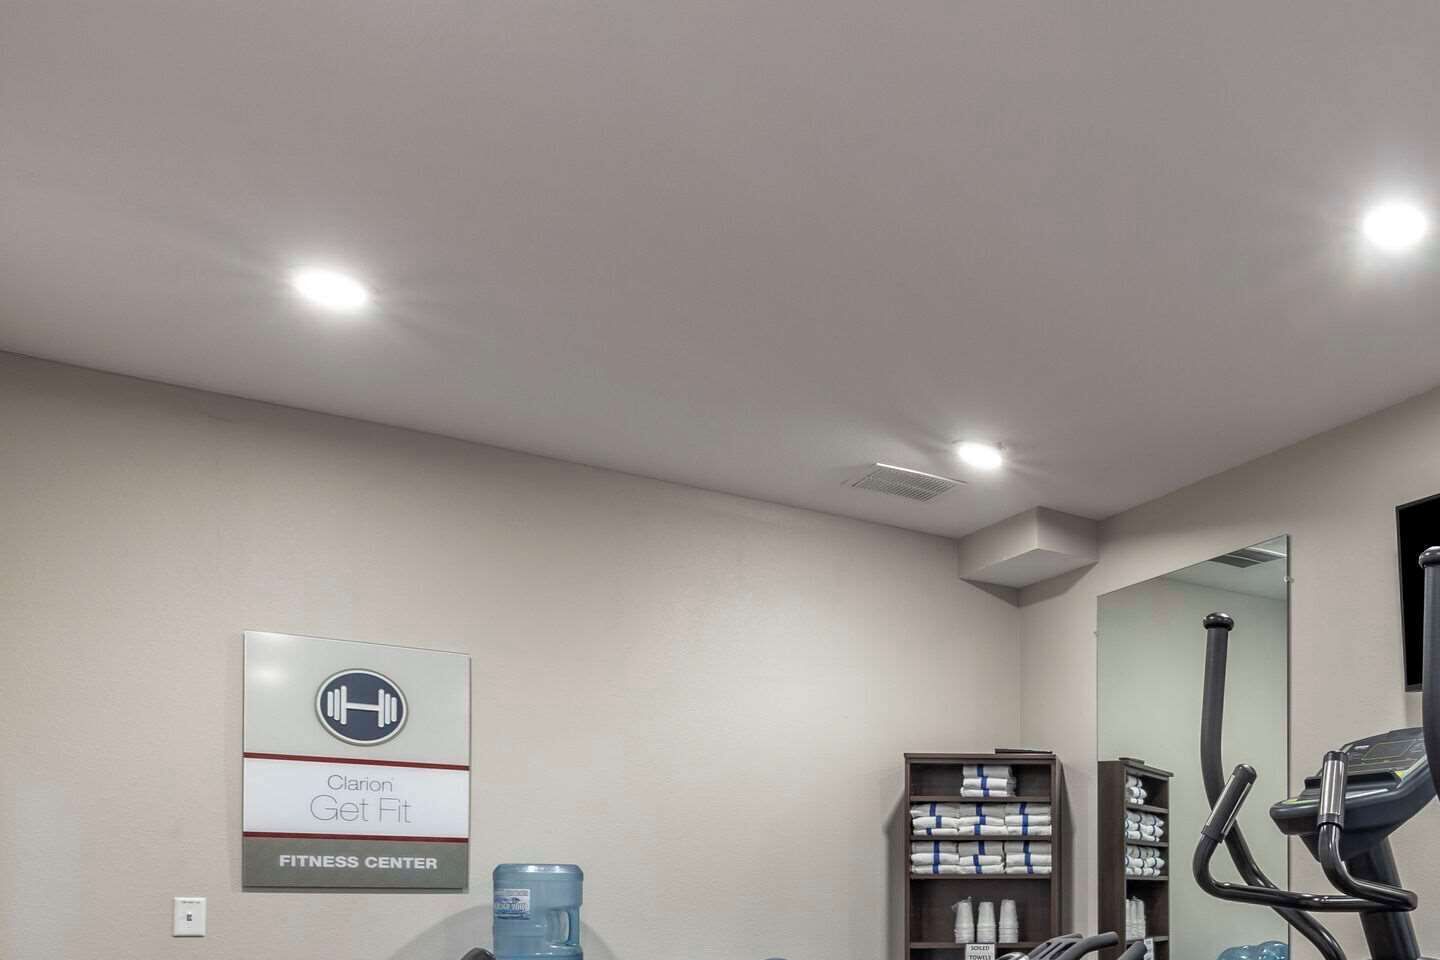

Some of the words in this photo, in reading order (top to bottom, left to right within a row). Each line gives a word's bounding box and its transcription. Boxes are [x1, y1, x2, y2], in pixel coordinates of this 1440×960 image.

[327, 774, 393, 792] Clarion
[310, 794, 369, 822] Get
[378, 797, 413, 824] Fit
[279, 854, 359, 869] FITNESS
[364, 856, 438, 870] CENTER
